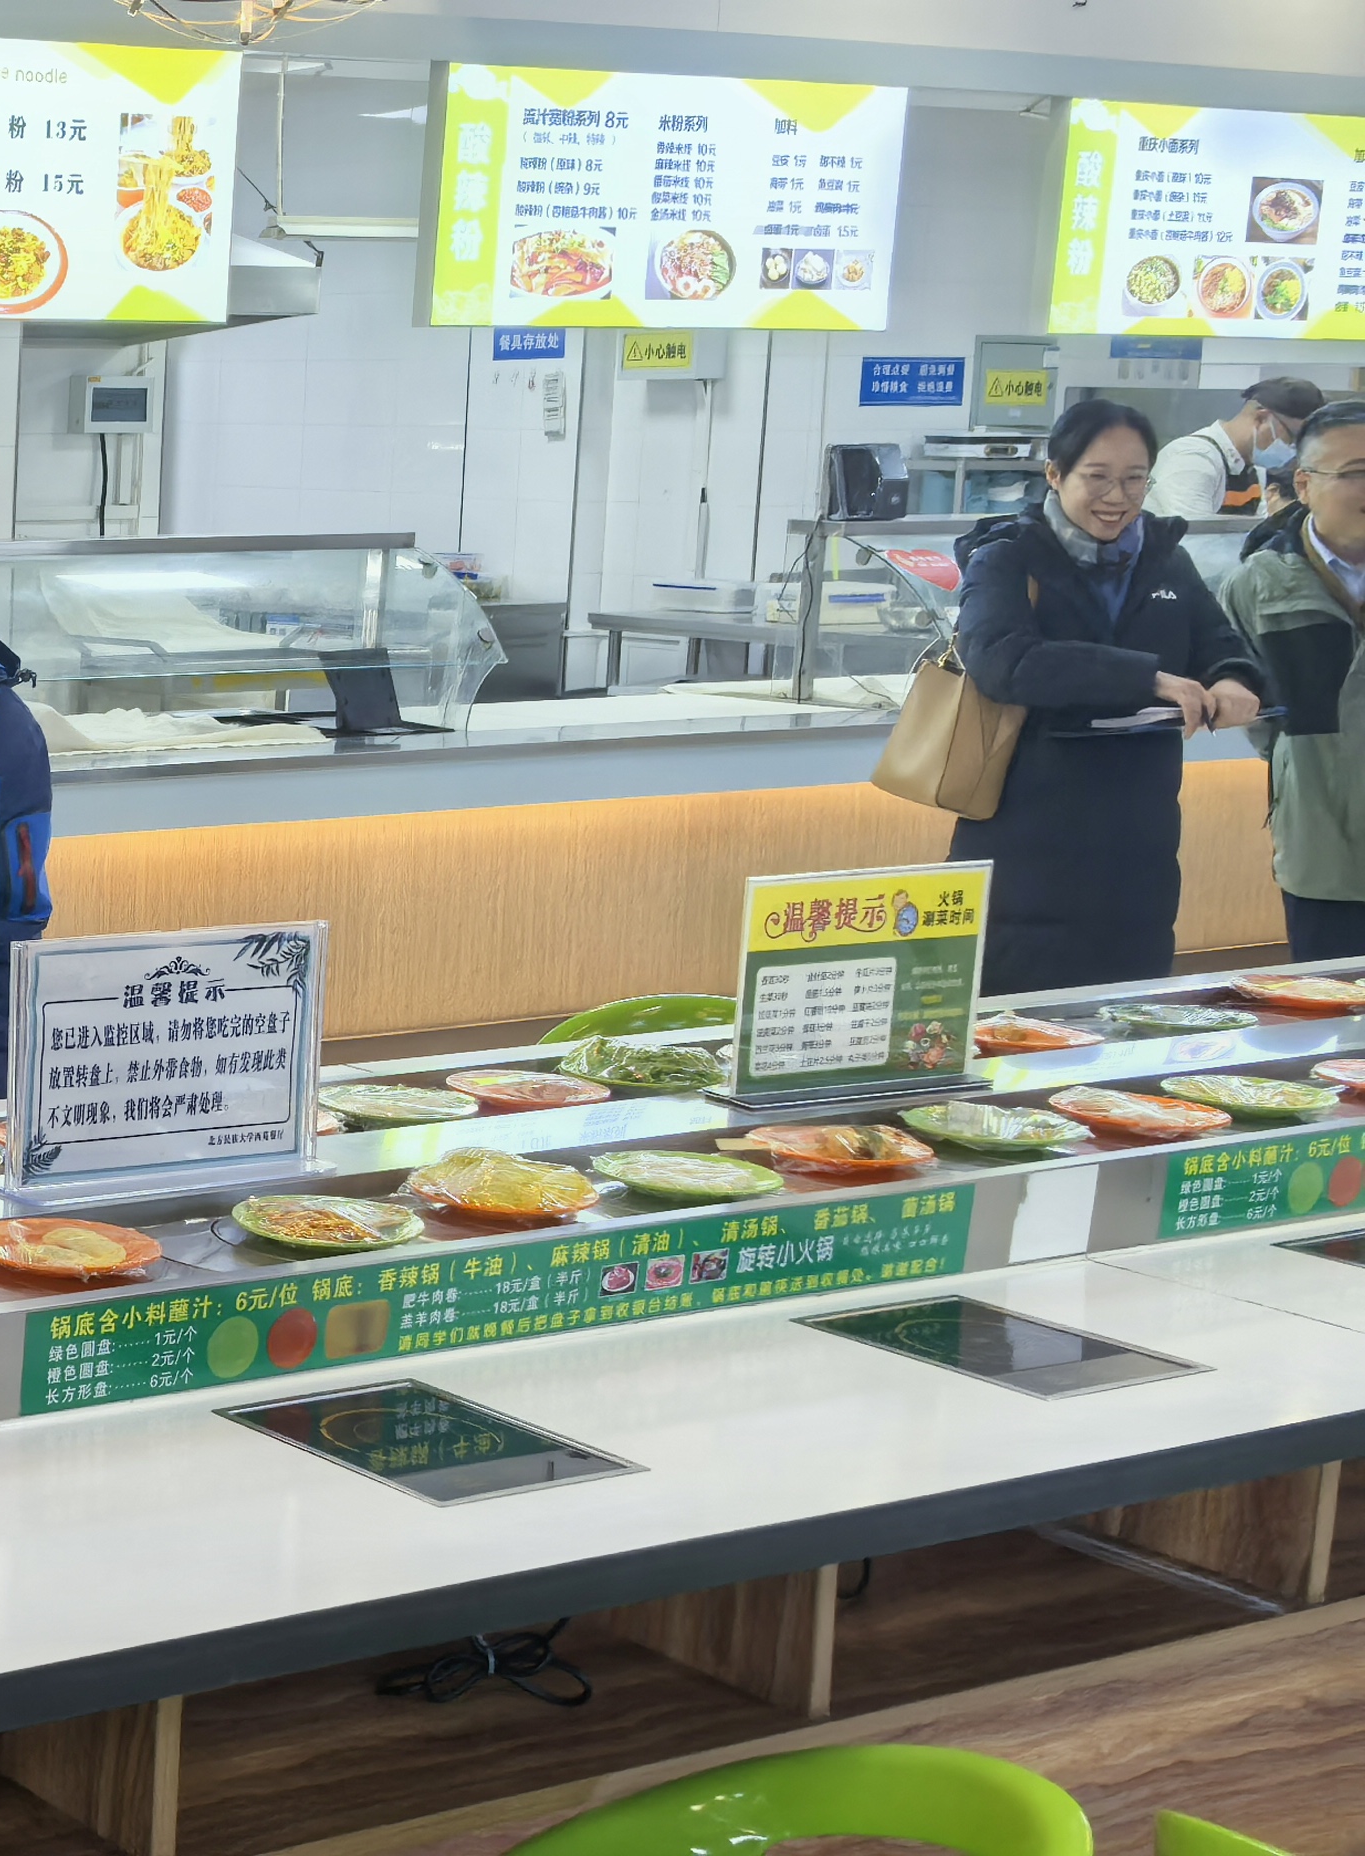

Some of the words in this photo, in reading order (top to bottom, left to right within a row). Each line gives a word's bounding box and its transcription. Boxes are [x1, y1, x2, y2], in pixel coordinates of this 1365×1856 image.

[14, 68, 68, 84] noodle
[45, 118, 88, 141] 13元
[604, 110, 630, 130] 8元
[657, 113, 709, 134] 米粉系列
[697, 142, 717, 157] 10元
[1137, 135, 1200, 155] 重庆小面系列
[695, 159, 716, 173] 10元
[42, 172, 85, 195] 15元
[449, 121, 493, 263] 酸辣粉
[1064, 150, 1105, 277] 酸辣粉
[498, 333, 560, 351] 餐具存放处
[644, 342, 688, 360] 小心触电
[1004, 379, 1043, 397] 小心触电
[938, 889, 964, 908] 火锅
[766, 892, 887, 942] 温馨提示
[921, 908, 975, 928] 涮菜时间
[122, 978, 227, 1009] 温馨提示
[50, 1010, 291, 1051] 您已进入监控区域，请勿将您吃完的空盘子
[48, 1047, 287, 1091] 放置转盘上，禁止外带食物，如有发现此类
[47, 1090, 229, 1128] 不文明现象，我们将会严肃处理。
[1251, 1168, 1283, 1184] 1元/个
[1248, 1186, 1280, 1202] 2元/个
[1246, 1203, 1278, 1220] 6元/个
[735, 1234, 835, 1275] 旋转小火锅
[49, 1284, 298, 1341] 锅底含小料蘸汁：6元/位
[311, 1273, 364, 1302] 锅底：
[47, 1337, 118, 1363] 绿色圆盘：
[152, 1324, 198, 1347] 1元/个
[46, 1358, 116, 1385] 橙色圆盘：
[151, 1346, 196, 1369] 2元/个
[44, 1378, 112, 1406] 长方形盘：
[149, 1367, 195, 1390] 6元/个
